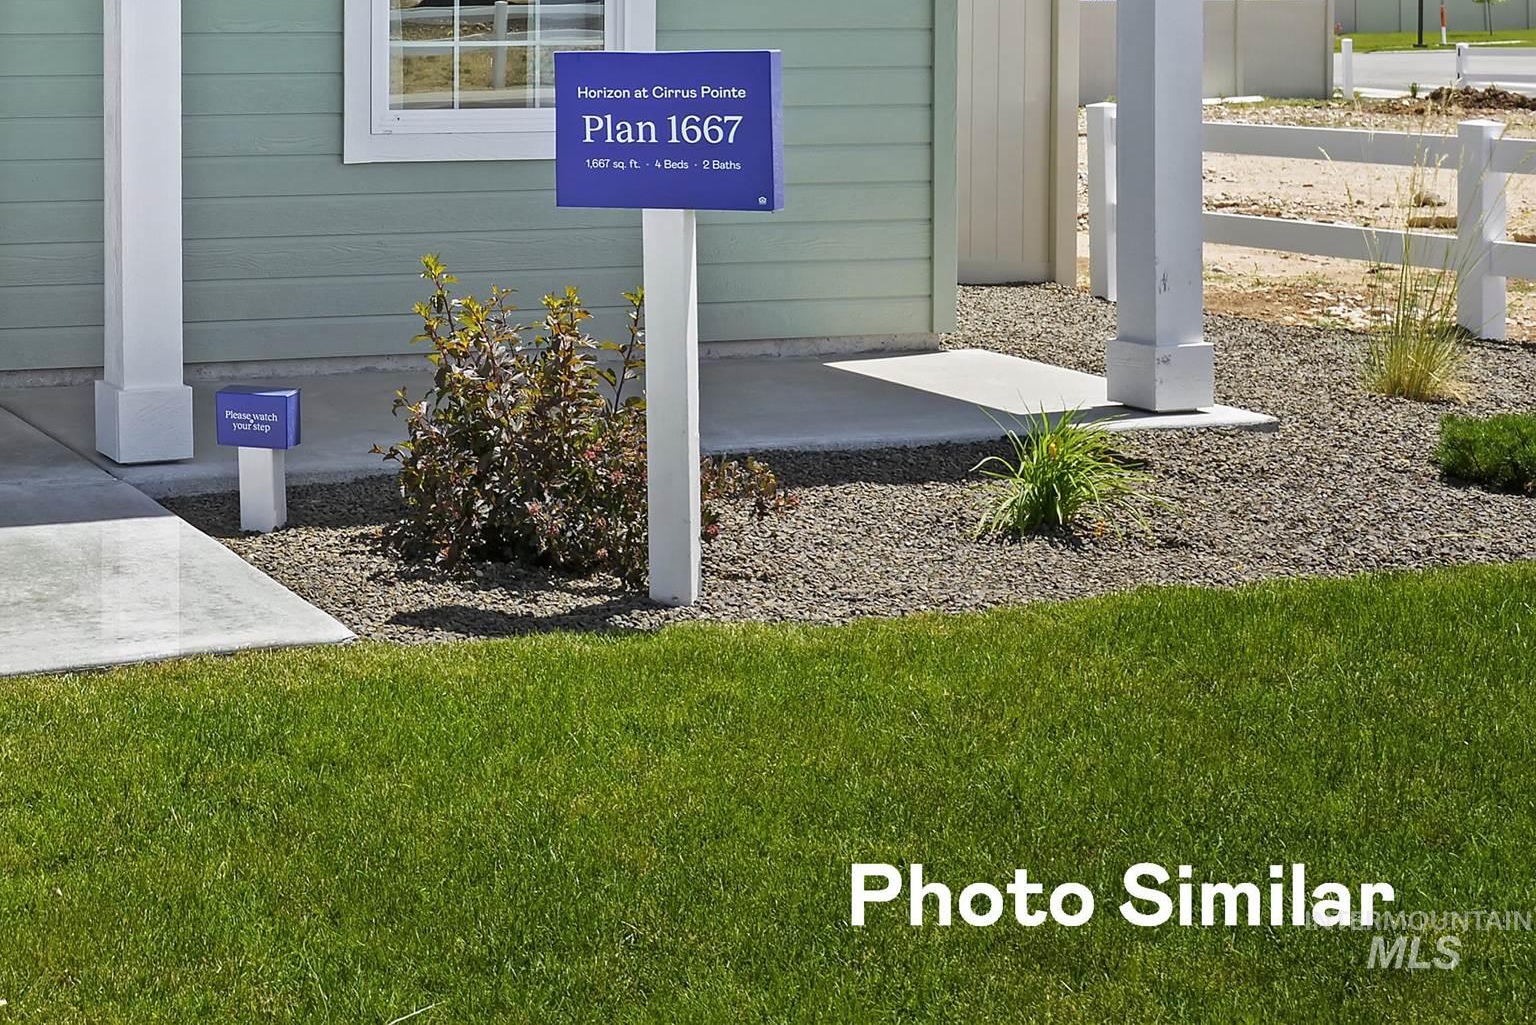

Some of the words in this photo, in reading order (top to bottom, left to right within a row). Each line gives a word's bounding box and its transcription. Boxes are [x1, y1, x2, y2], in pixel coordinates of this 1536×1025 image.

[577, 86, 630, 99] Horizon
[634, 86, 649, 99] at
[652, 86, 697, 99] Cirrus
[701, 86, 747, 99] Pointe
[582, 114, 658, 143] Plan
[667, 115, 743, 144] 1667
[585, 158, 611, 169] 1,667
[612, 160, 627, 171] sq.
[629, 158, 641, 169] ft.
[654, 159, 662, 169] 4
[664, 159, 689, 169] Beds
[702, 159, 710, 170] 2
[712, 159, 742, 170] Baths
[225, 410, 251, 420] Please
[253, 413, 278, 422] watch
[233, 422, 252, 431] your
[253, 422, 271, 433] step
